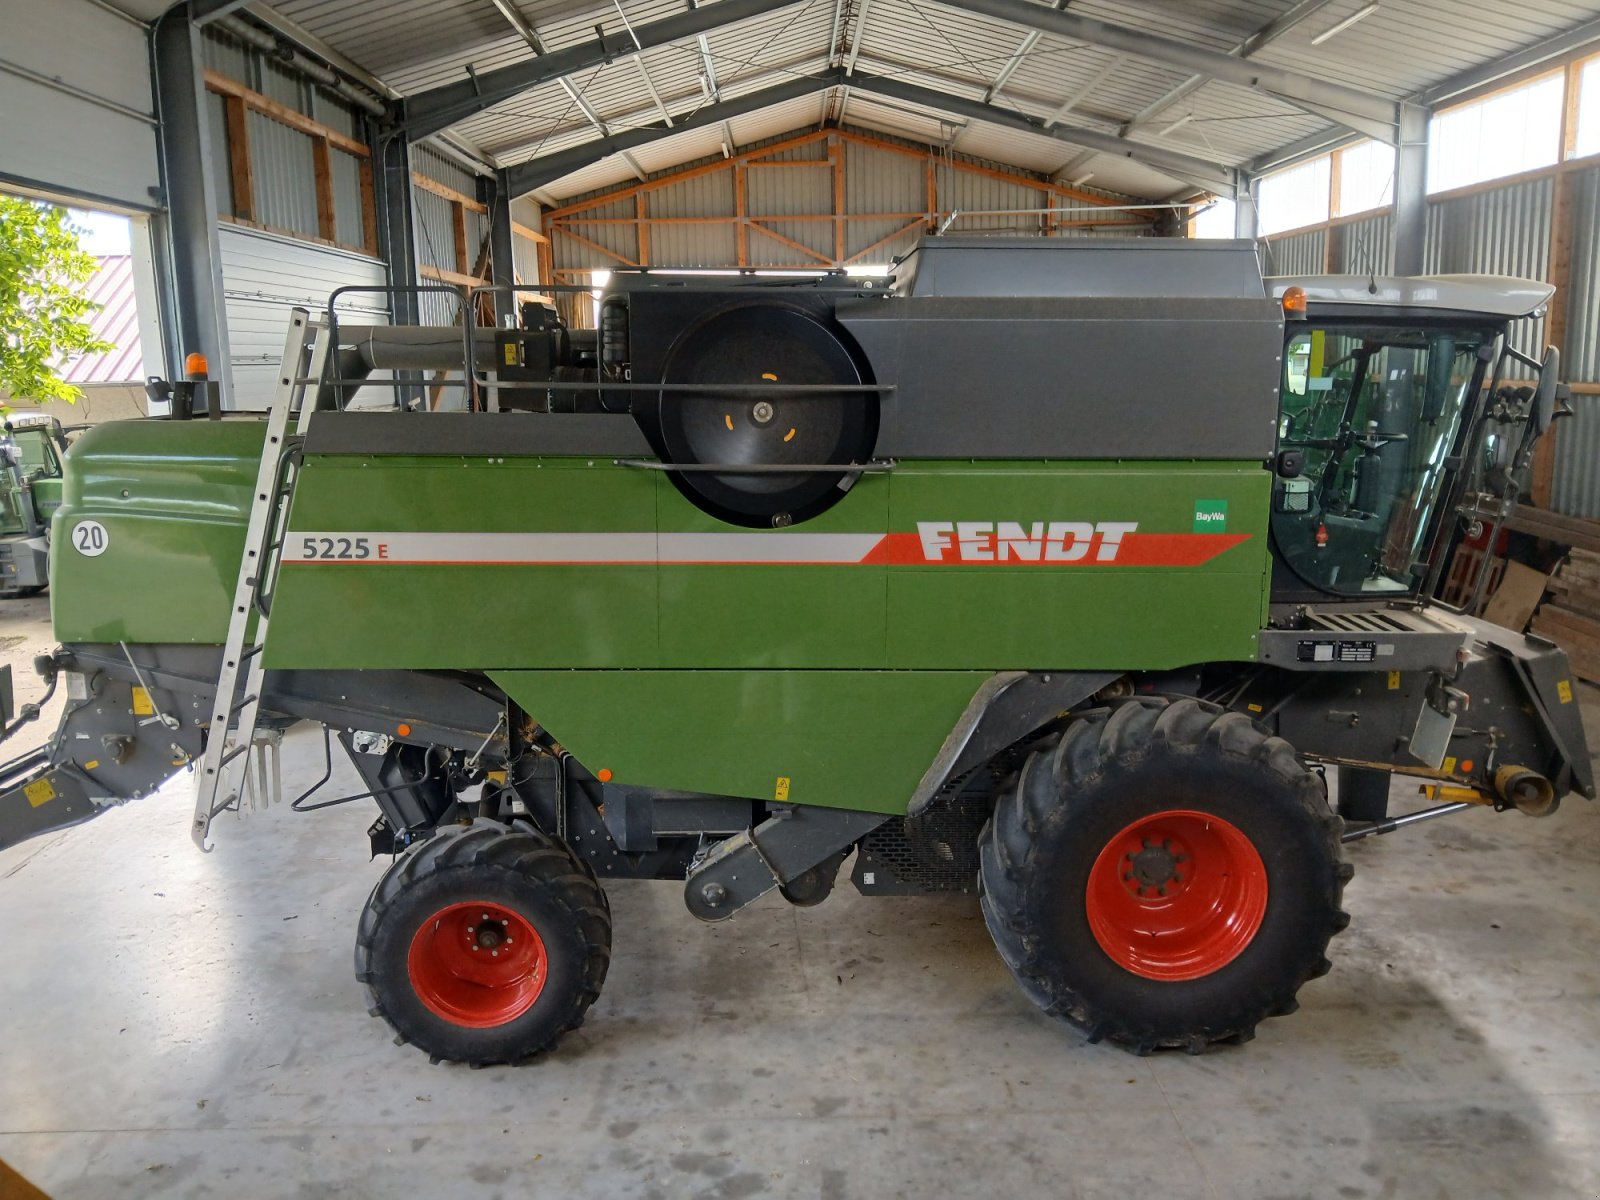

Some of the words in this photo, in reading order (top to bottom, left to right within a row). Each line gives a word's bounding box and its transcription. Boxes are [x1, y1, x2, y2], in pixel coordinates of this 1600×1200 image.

[1195, 511, 1225, 522] BayWa
[77, 525, 103, 550] 20
[303, 537, 370, 559] 5225
[377, 543, 389, 559] E
[916, 521, 1139, 561] FENDT
